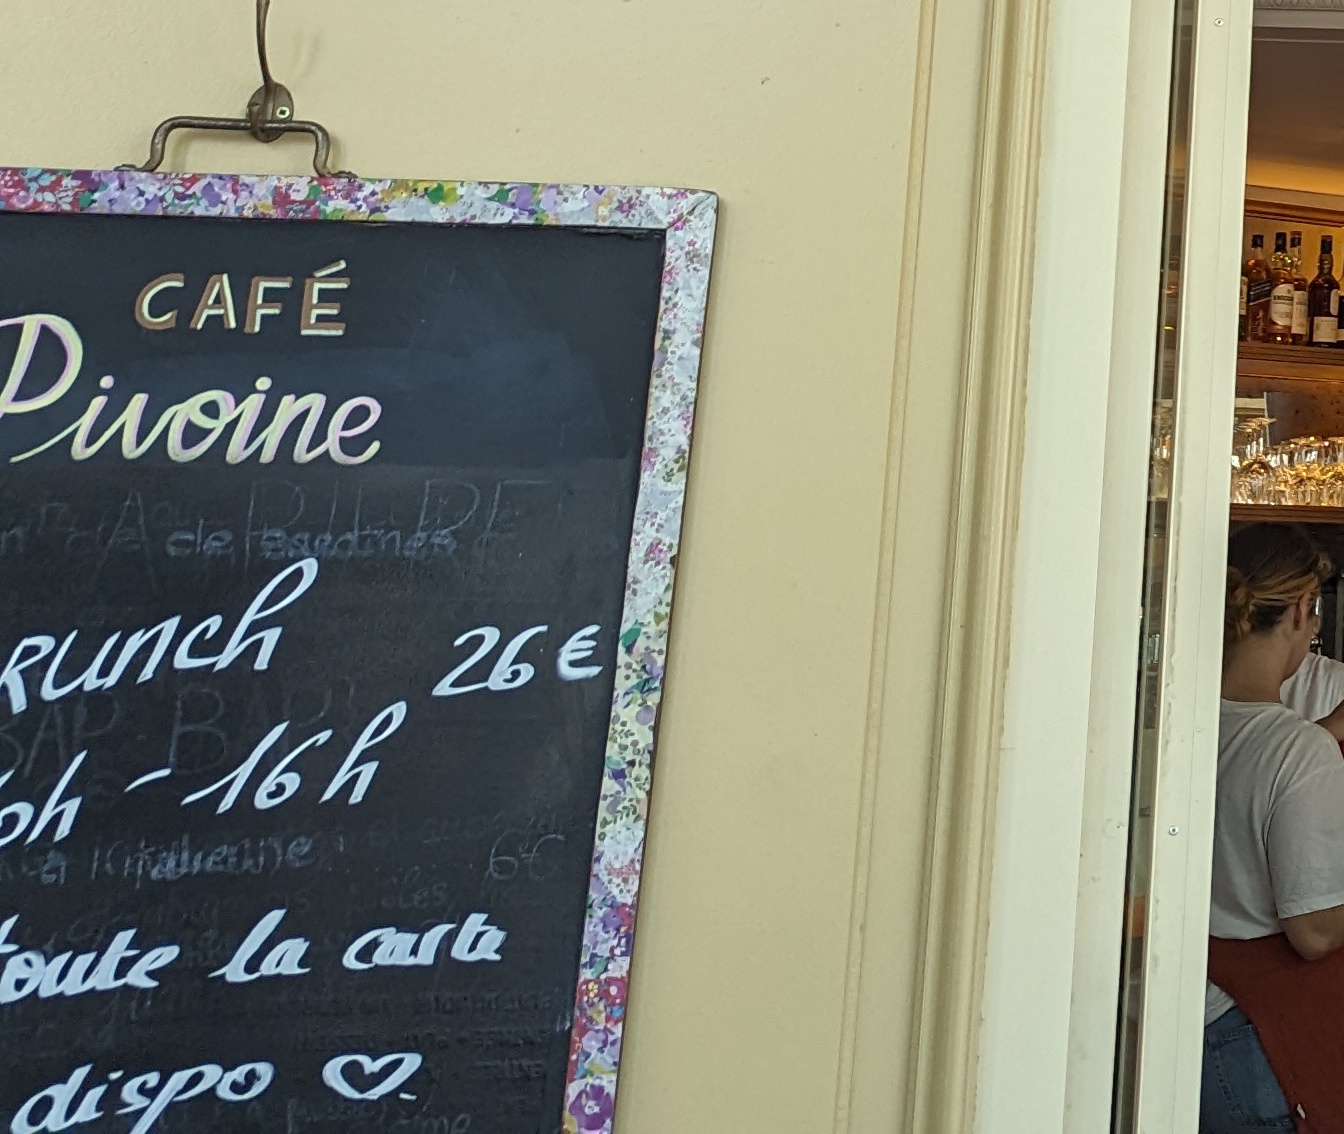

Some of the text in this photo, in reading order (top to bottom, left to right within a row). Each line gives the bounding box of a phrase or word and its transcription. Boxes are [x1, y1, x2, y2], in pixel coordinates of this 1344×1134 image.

[135, 259, 351, 336] CAFÉ
[0, 313, 382, 465] Pivoine
[0, 751, 88, 846] 0h
[208, 908, 311, 983] la
[342, 912, 508, 969] carte
[10, 1063, 275, 1134] dispo
